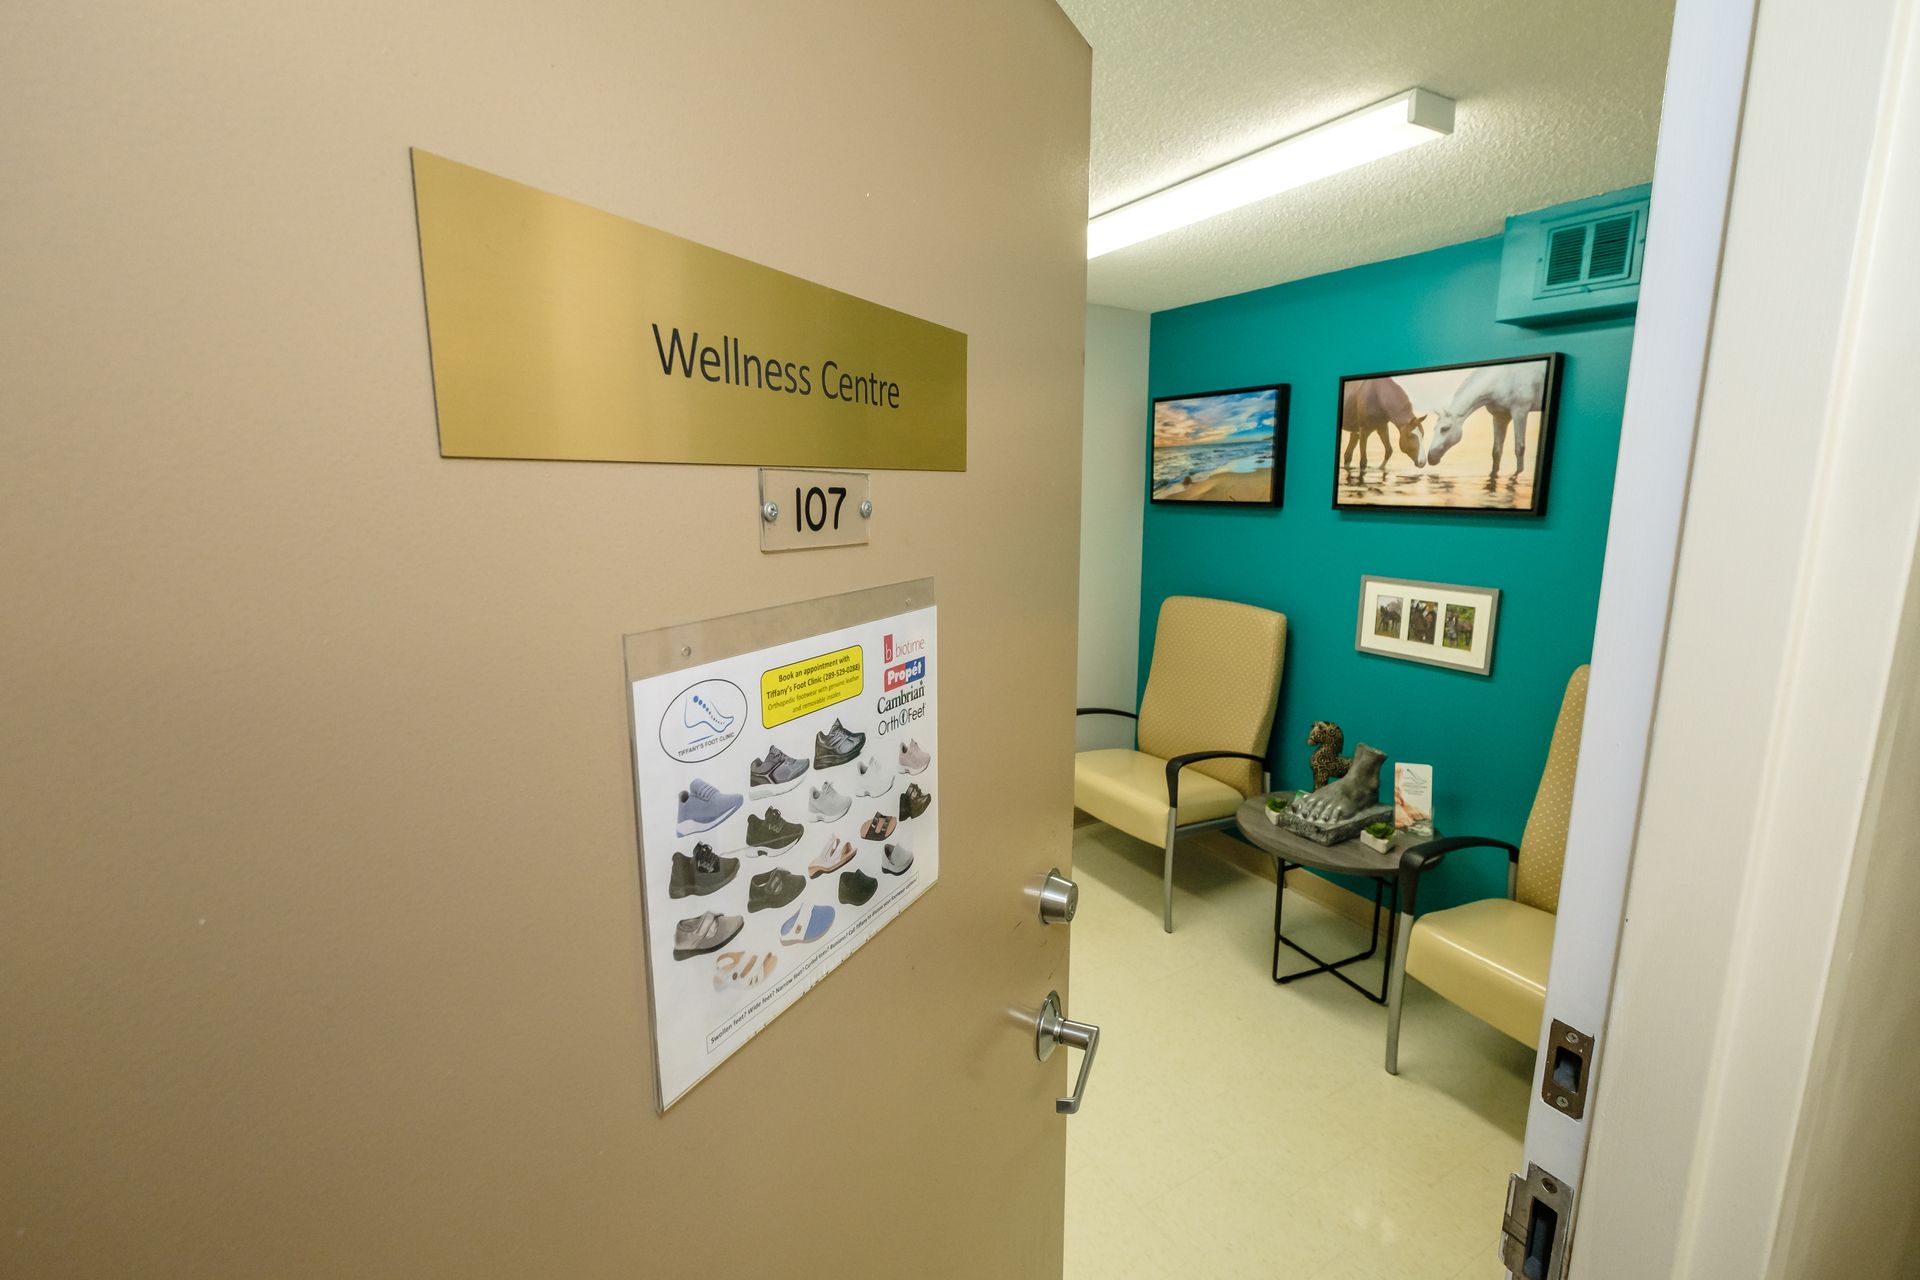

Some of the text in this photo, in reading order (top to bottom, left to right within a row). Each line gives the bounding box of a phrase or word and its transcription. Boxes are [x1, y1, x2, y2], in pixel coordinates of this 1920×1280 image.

[652, 323, 900, 409] Wellness Centre
[795, 486, 847, 532] 107
[778, 655, 851, 682] Book an appointment with
[887, 661, 922, 685] Propét
[766, 685, 793, 699] Tiffany's
[793, 681, 807, 690] Foot
[807, 676, 822, 687] Clinic
[767, 675, 860, 711] Orthopedic footwear with genuine leather
[877, 684, 925, 714] Cambrian
[792, 703, 802, 713] and
[802, 697, 826, 709] removable
[677, 731, 735, 758] TIFFANY'S FOOT CLINIC
[710, 1024, 733, 1044] Swollen
[733, 1011, 747, 1026] feet?
[747, 1001, 761, 1015] Wide
[762, 990, 775, 1004] feet?
[775, 978, 793, 993] Narrow
[793, 966, 805, 981] feet?
[805, 956, 818, 970] Curled
[848, 927, 856, 936] Call
